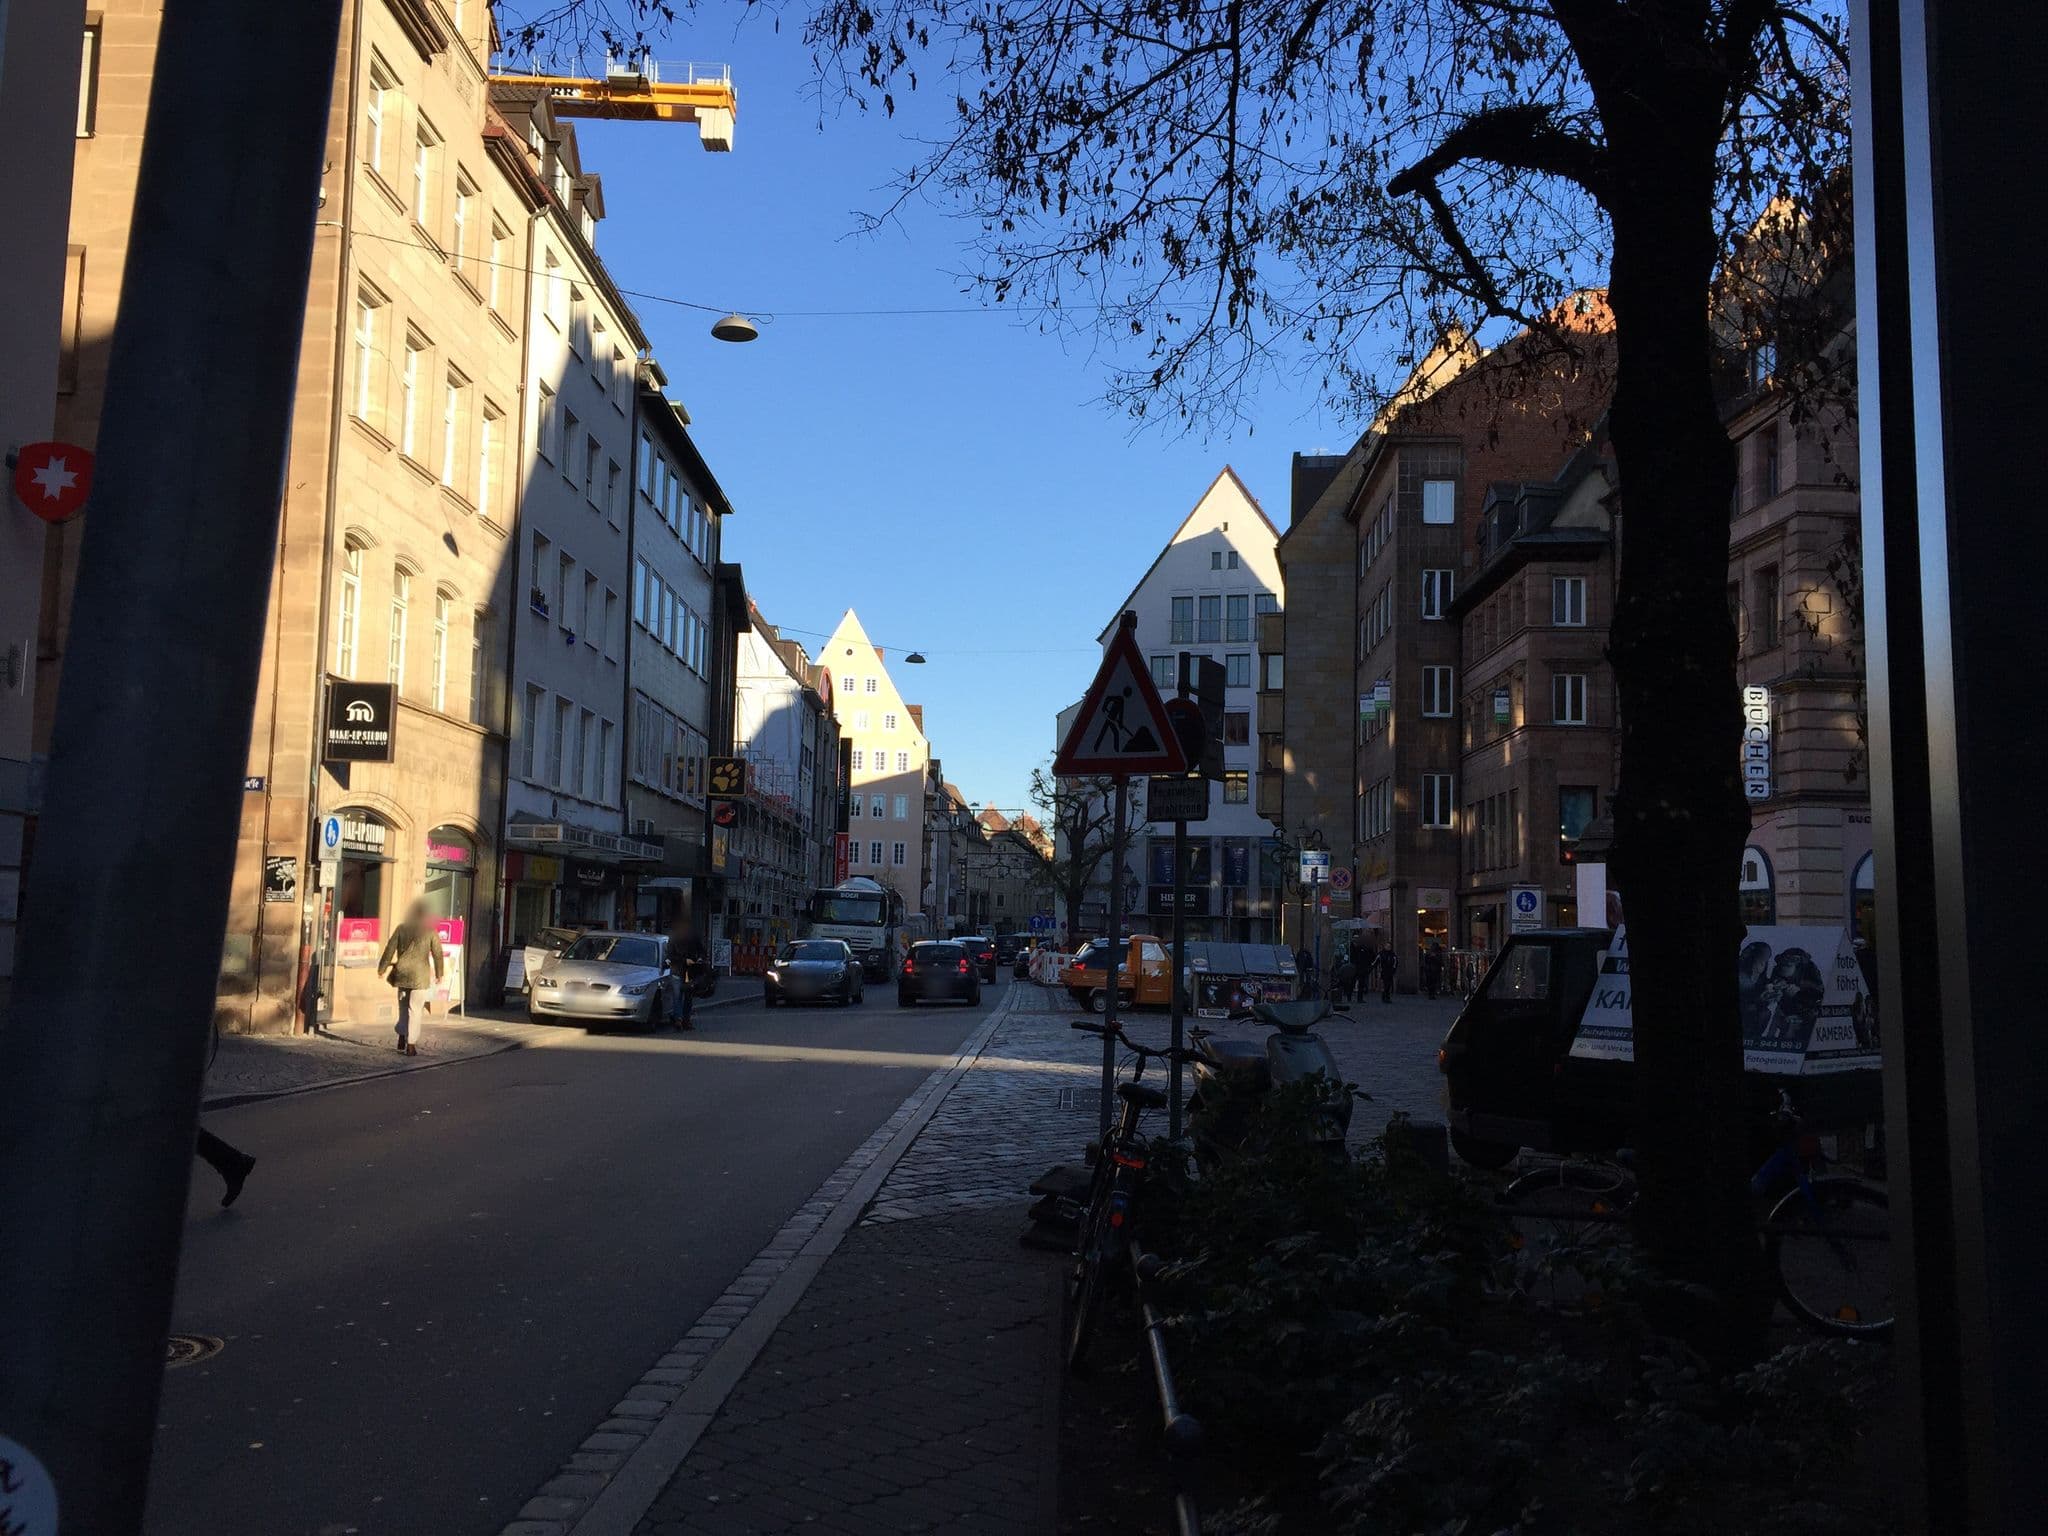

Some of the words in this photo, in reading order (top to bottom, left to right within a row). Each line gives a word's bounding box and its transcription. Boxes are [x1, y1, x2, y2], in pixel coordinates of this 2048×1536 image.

[550, 87, 574, 96] RR
[329, 729, 362, 741] MAKE-UP
[362, 731, 388, 741] STUDIO
[1816, 1025, 1854, 1041] KAMERAS
